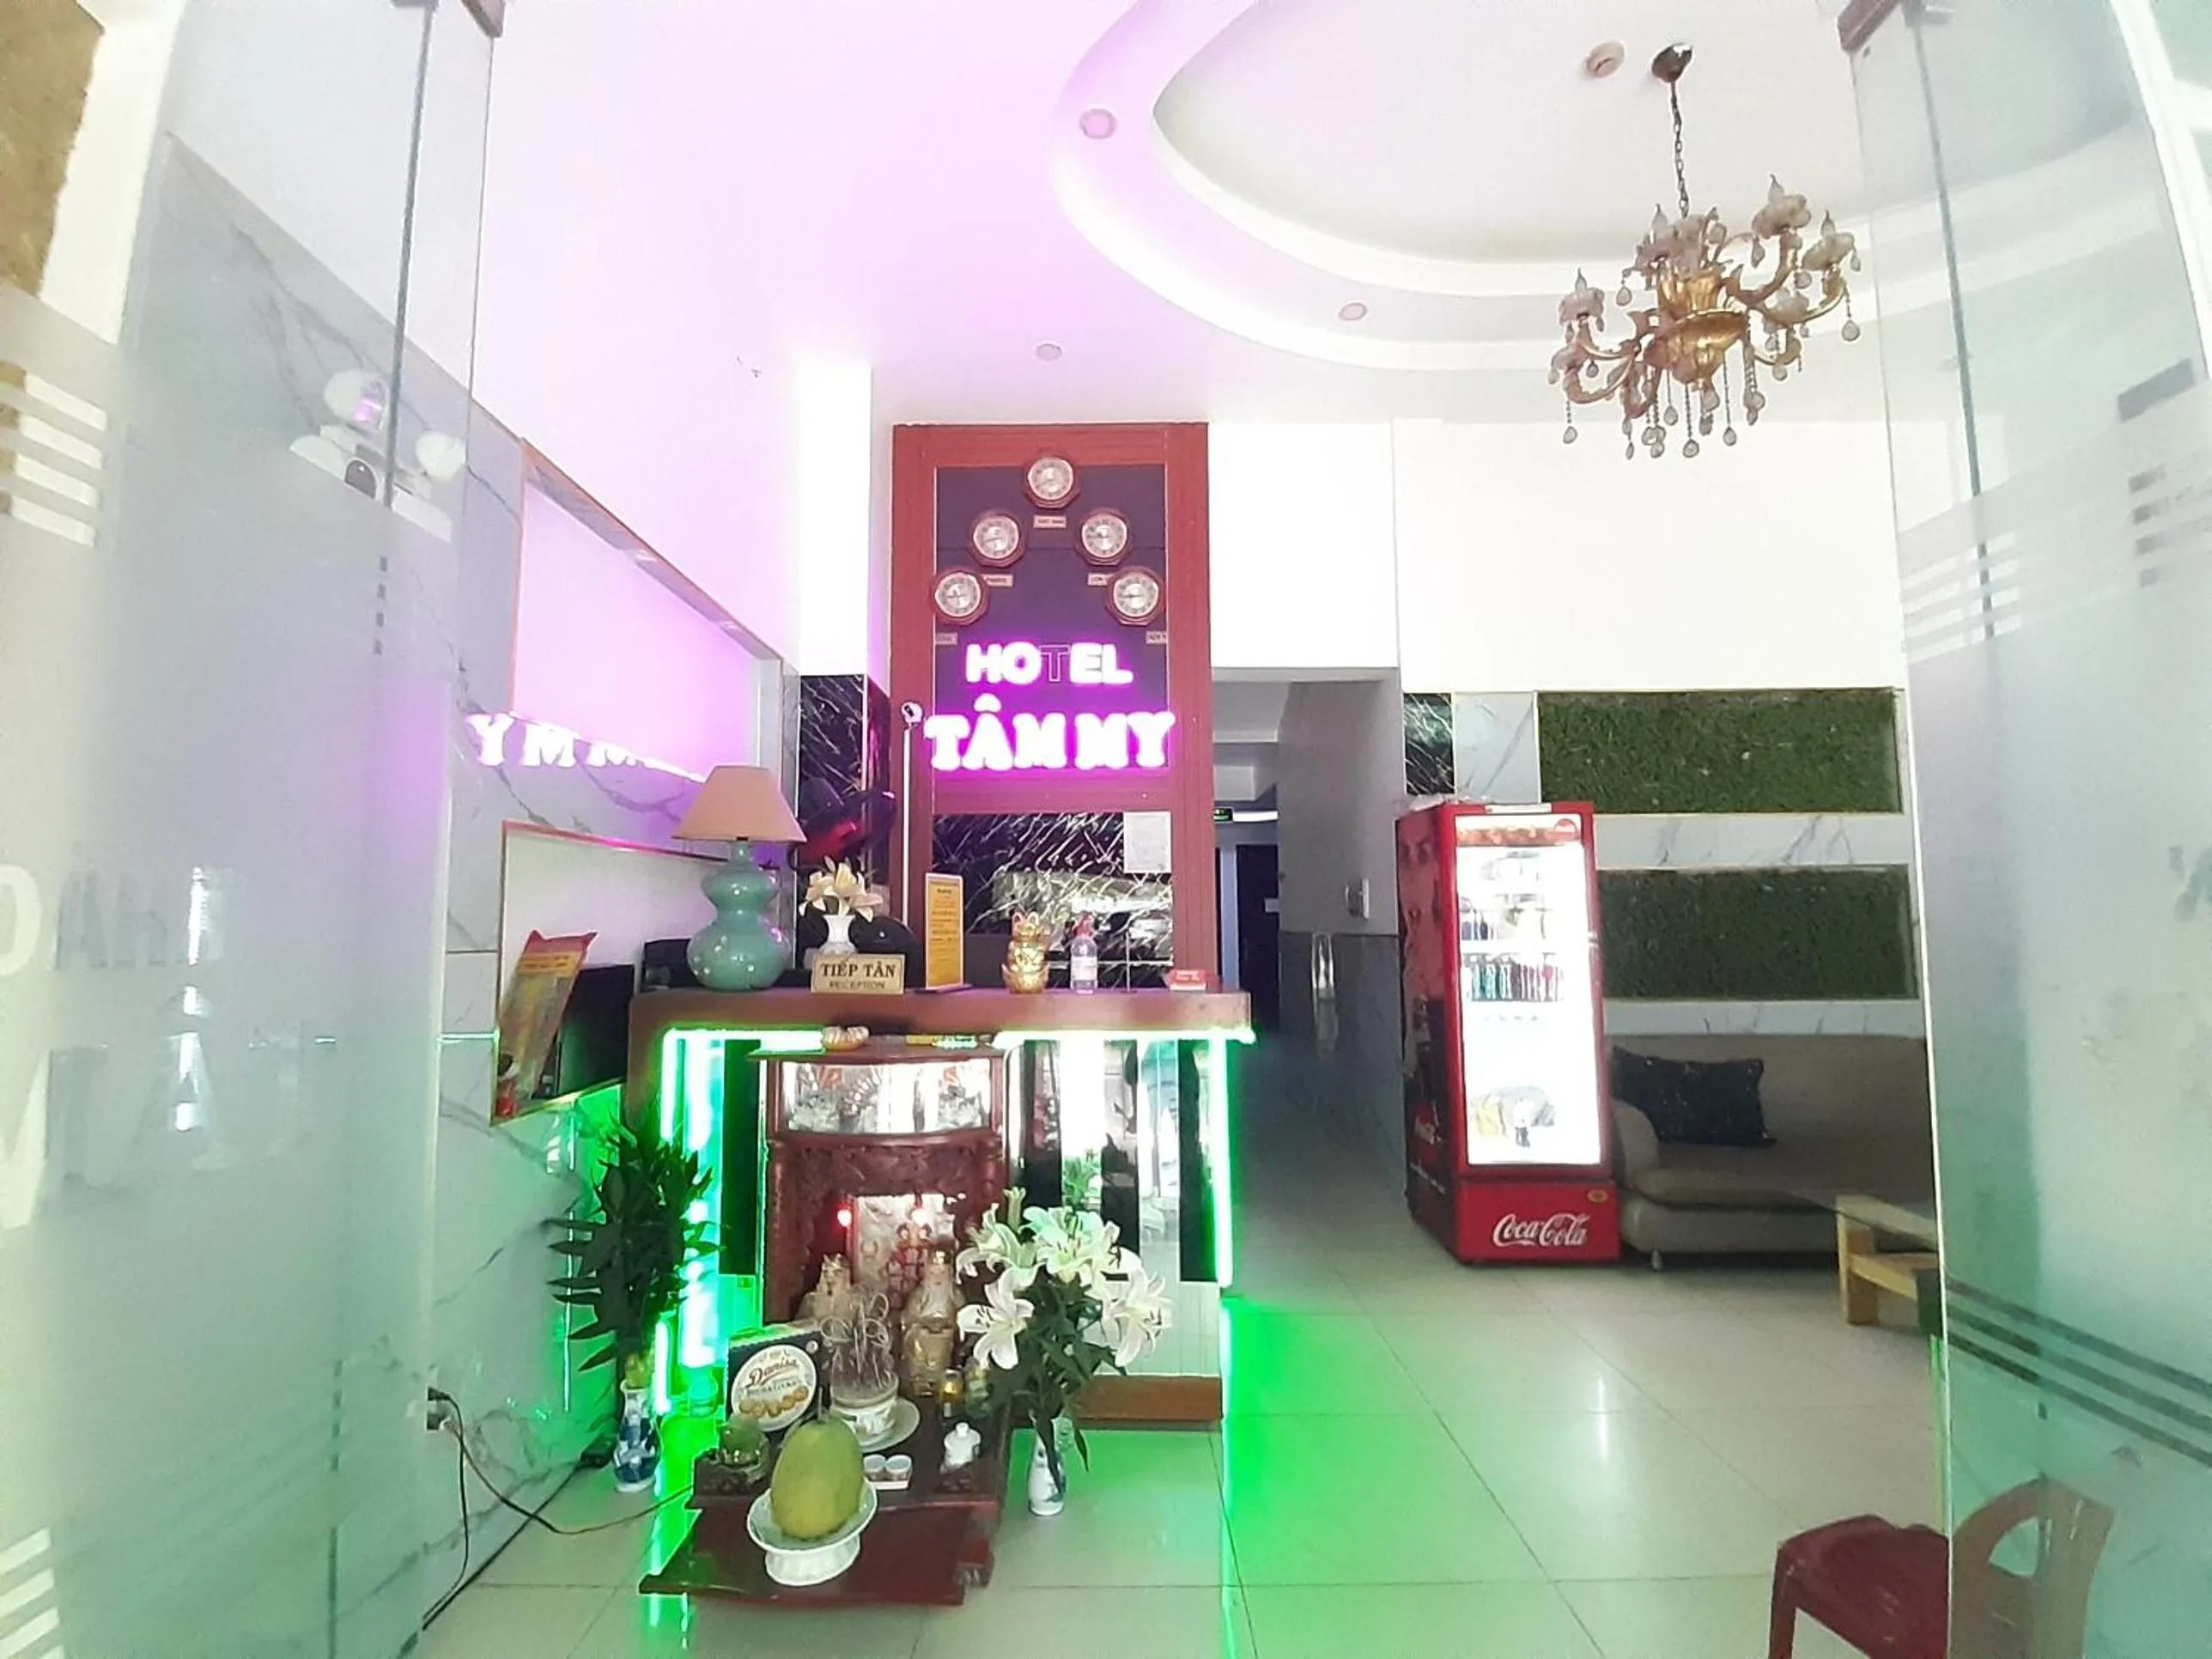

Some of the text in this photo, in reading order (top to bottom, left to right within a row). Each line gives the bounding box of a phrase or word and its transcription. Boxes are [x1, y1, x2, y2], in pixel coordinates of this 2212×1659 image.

[966, 642, 1133, 684] HOTEL
[924, 693, 1176, 770] TÂM MY
[820, 958, 896, 978] TIẾP TÂN
